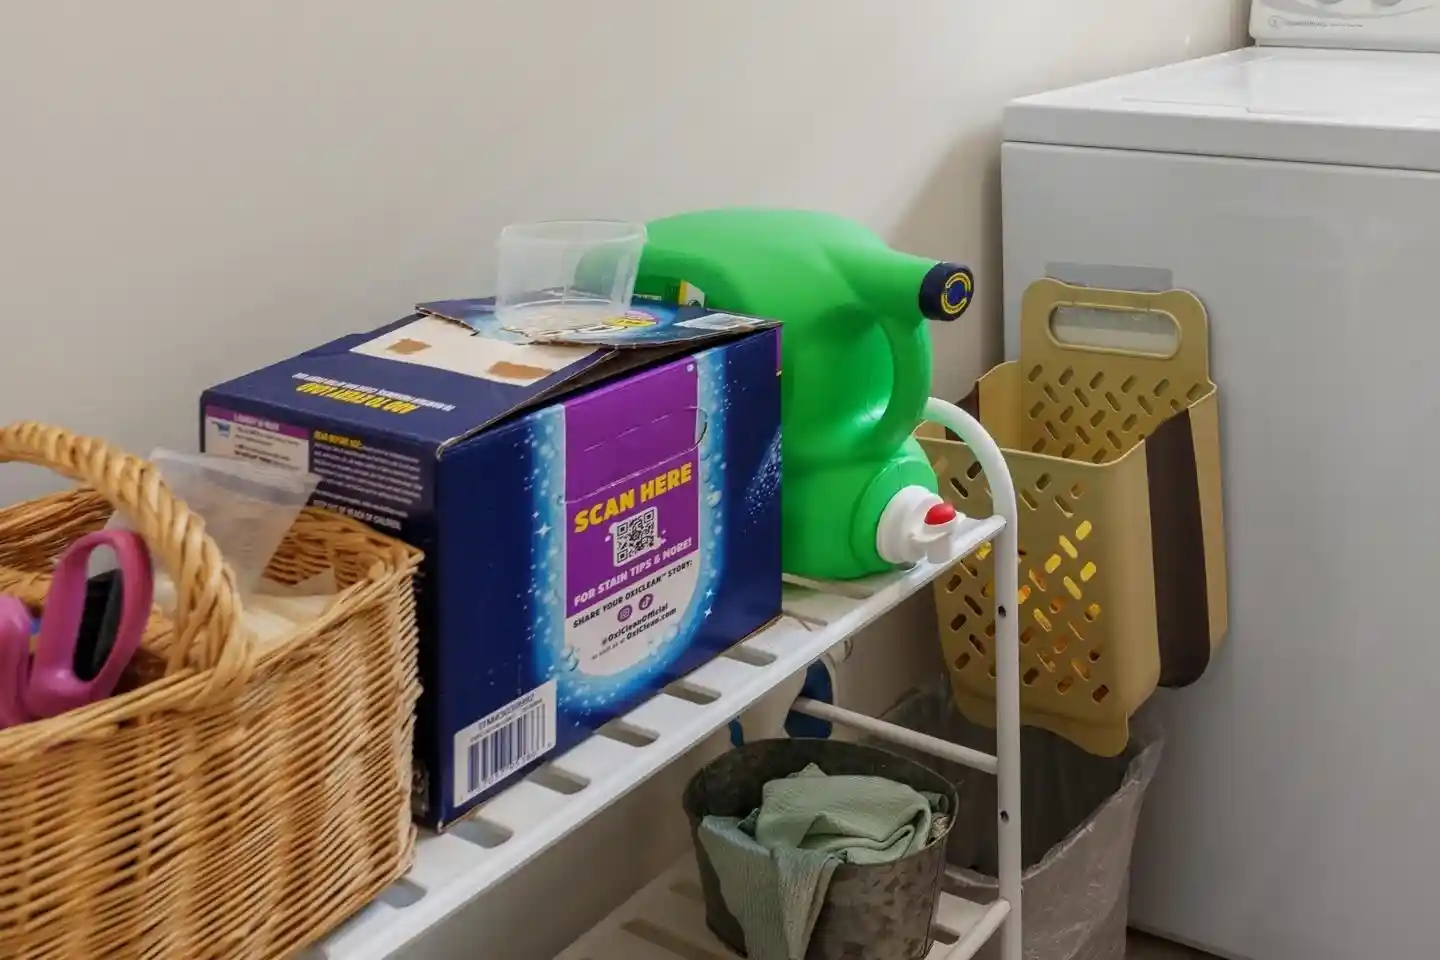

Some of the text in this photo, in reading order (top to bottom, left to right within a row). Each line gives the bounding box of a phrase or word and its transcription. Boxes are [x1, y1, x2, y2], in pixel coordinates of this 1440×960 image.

[574, 462, 692, 533] SCAN HERE
[572, 607, 601, 628] SHARE
[602, 596, 623, 612] YOUR
[668, 559, 693, 577] STORY:
[574, 588, 596, 606] FOR
[598, 571, 628, 594] STAIN
[630, 558, 652, 578] TIPS
[663, 537, 692, 560] MORE!
